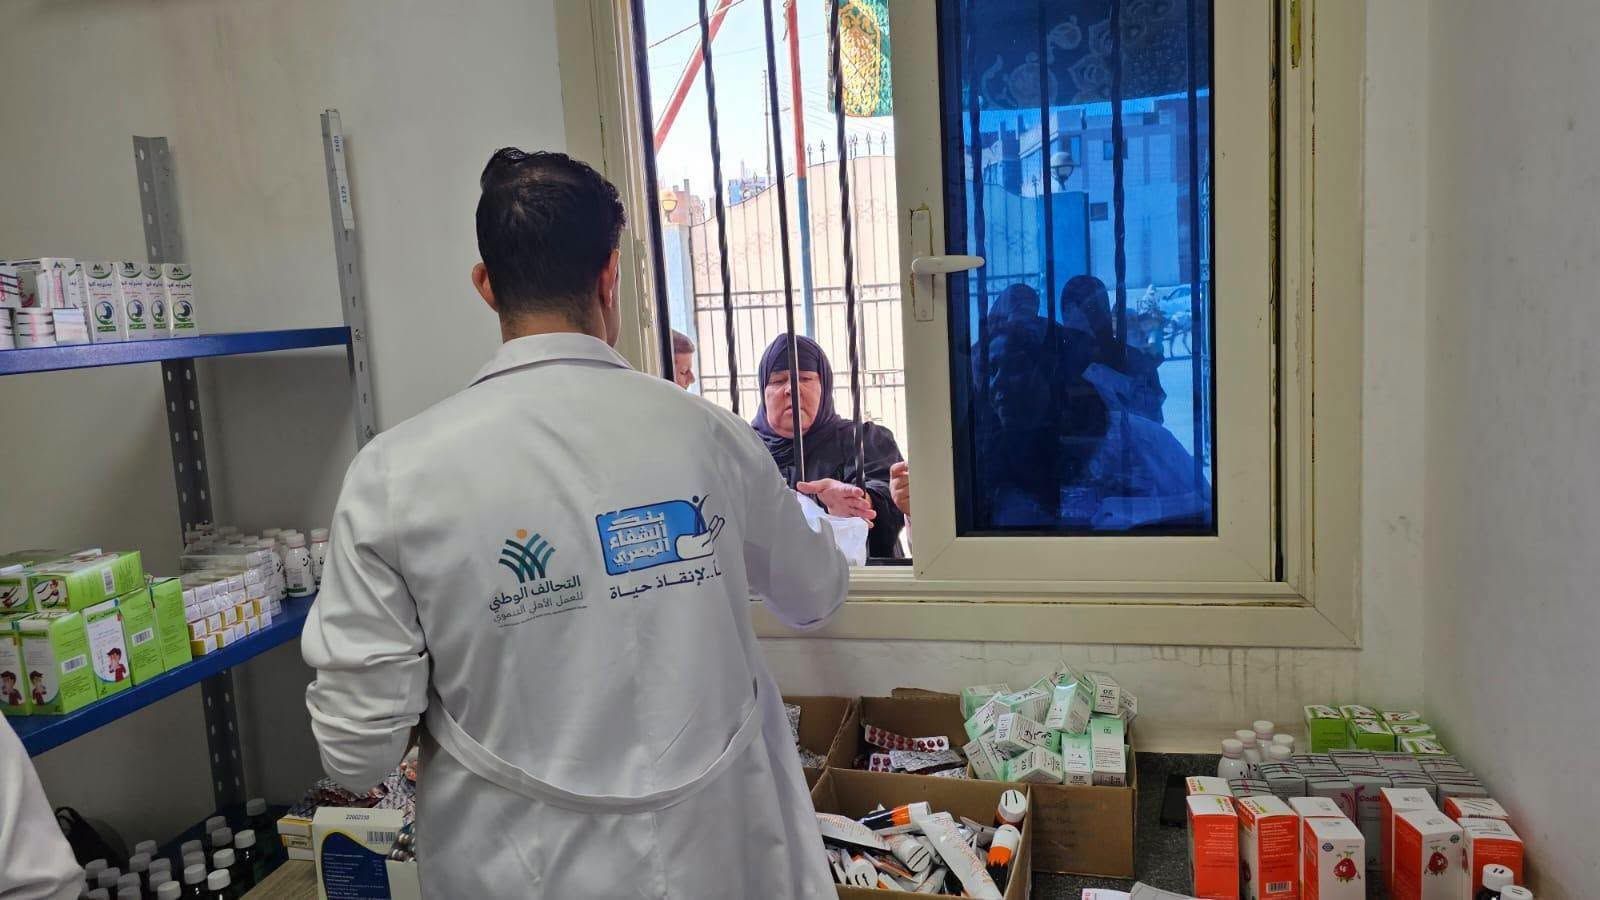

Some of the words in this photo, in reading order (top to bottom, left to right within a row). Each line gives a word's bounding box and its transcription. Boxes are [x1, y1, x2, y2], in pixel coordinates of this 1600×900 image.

[607, 511, 665, 531] بنك
[610, 522, 668, 549] الشفاء
[613, 537, 670, 567] المصري
[531, 575, 581, 595] التحالف
[610, 583, 652, 600] حياة
[489, 586, 529, 613] الوطني
[555, 592, 584, 607] للعمل
